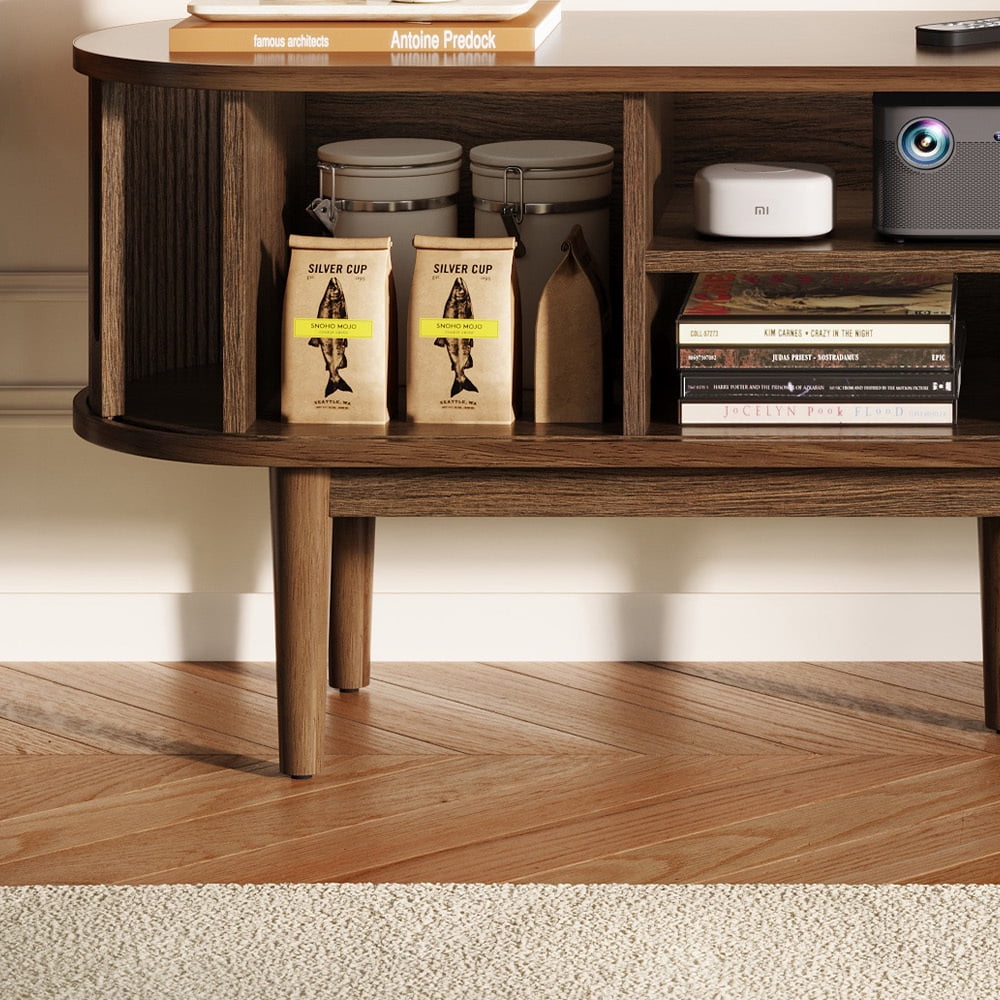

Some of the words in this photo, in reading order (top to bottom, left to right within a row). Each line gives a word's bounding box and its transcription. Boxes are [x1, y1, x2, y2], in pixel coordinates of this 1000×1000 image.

[253, 33, 286, 48] famous
[287, 33, 330, 48] architects
[390, 29, 440, 50] Antoine
[443, 29, 497, 50] Predock
[308, 263, 343, 274] SILVER
[346, 264, 368, 275] CUP
[433, 263, 469, 274] SILVER
[471, 264, 493, 275] CUP
[763, 329, 776, 337] KIM
[778, 329, 803, 338] CARNES
[810, 329, 830, 338] CRAZY
[832, 329, 839, 337] IN
[842, 329, 853, 338] THE
[854, 329, 874, 338] NIGHT
[771, 353, 790, 363] JUDAS
[791, 353, 812, 362] PRIEST
[931, 353, 946, 362] EPIC
